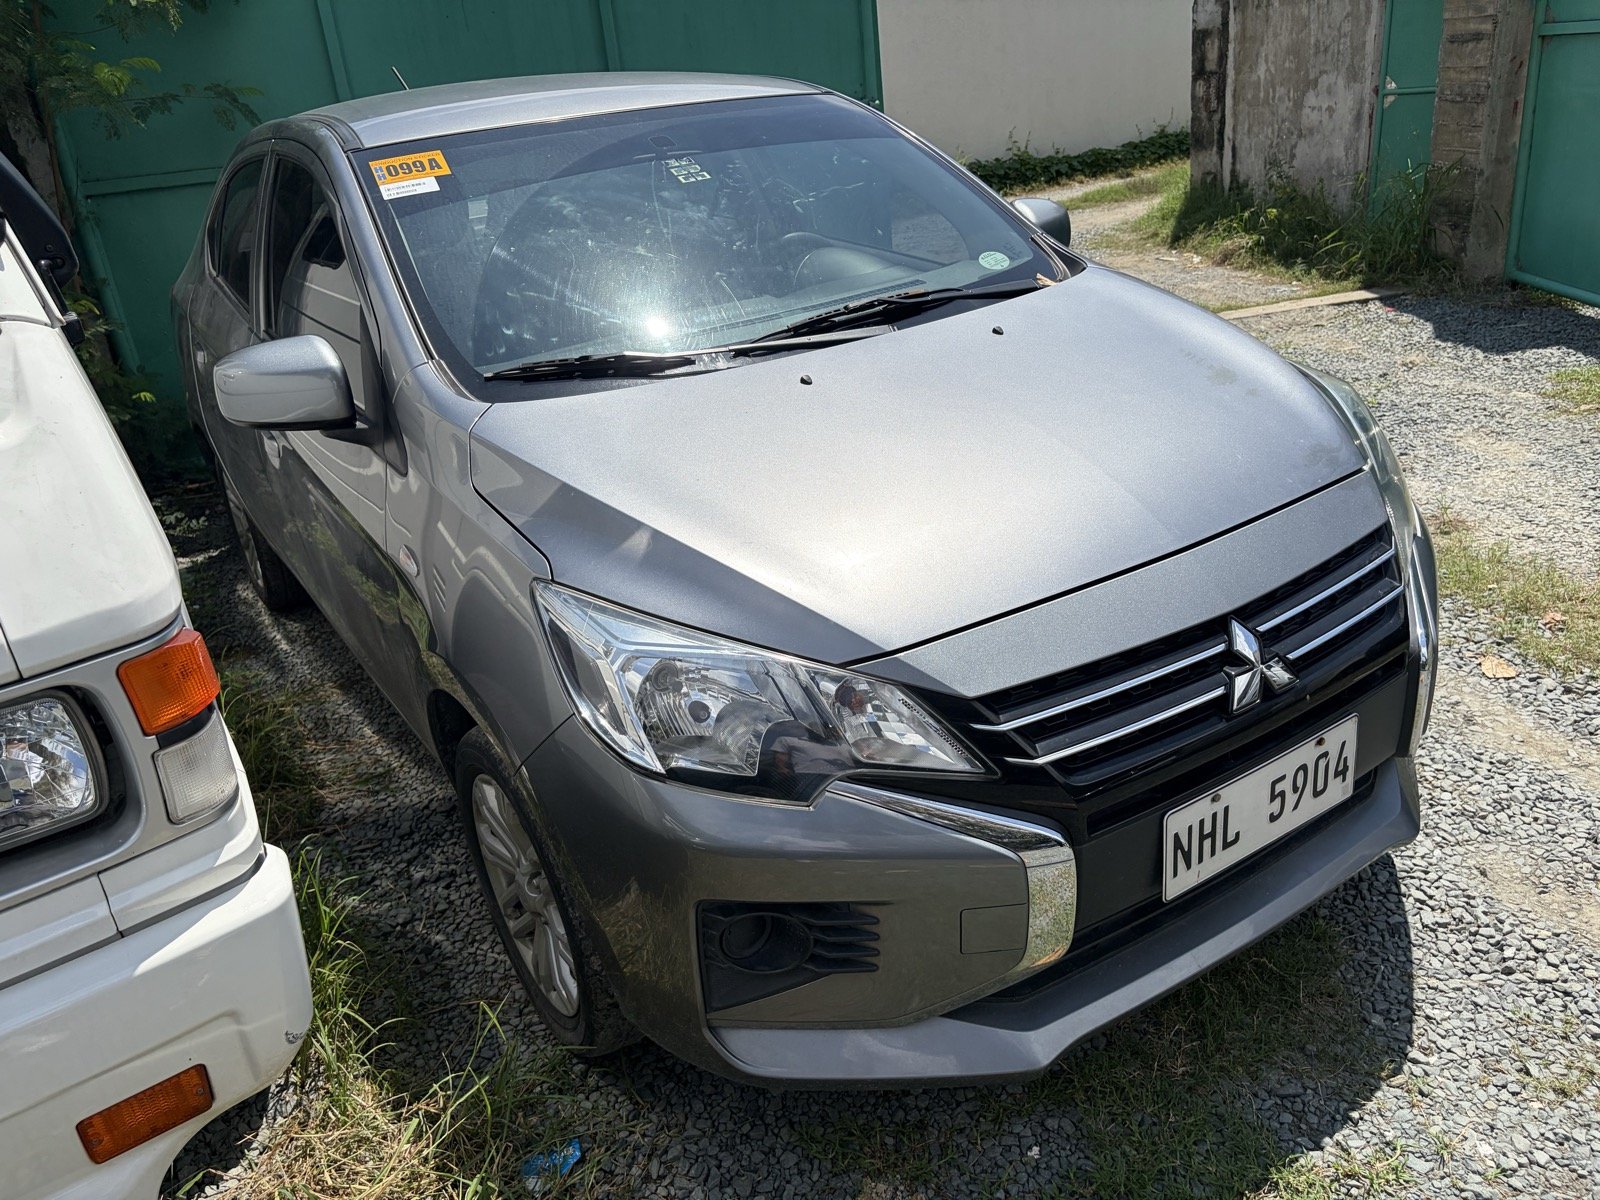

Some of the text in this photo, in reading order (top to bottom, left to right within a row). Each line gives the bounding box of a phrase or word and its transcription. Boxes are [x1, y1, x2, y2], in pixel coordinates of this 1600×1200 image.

[385, 158, 442, 177] 099A
[1172, 740, 1350, 879] NHL 5904
